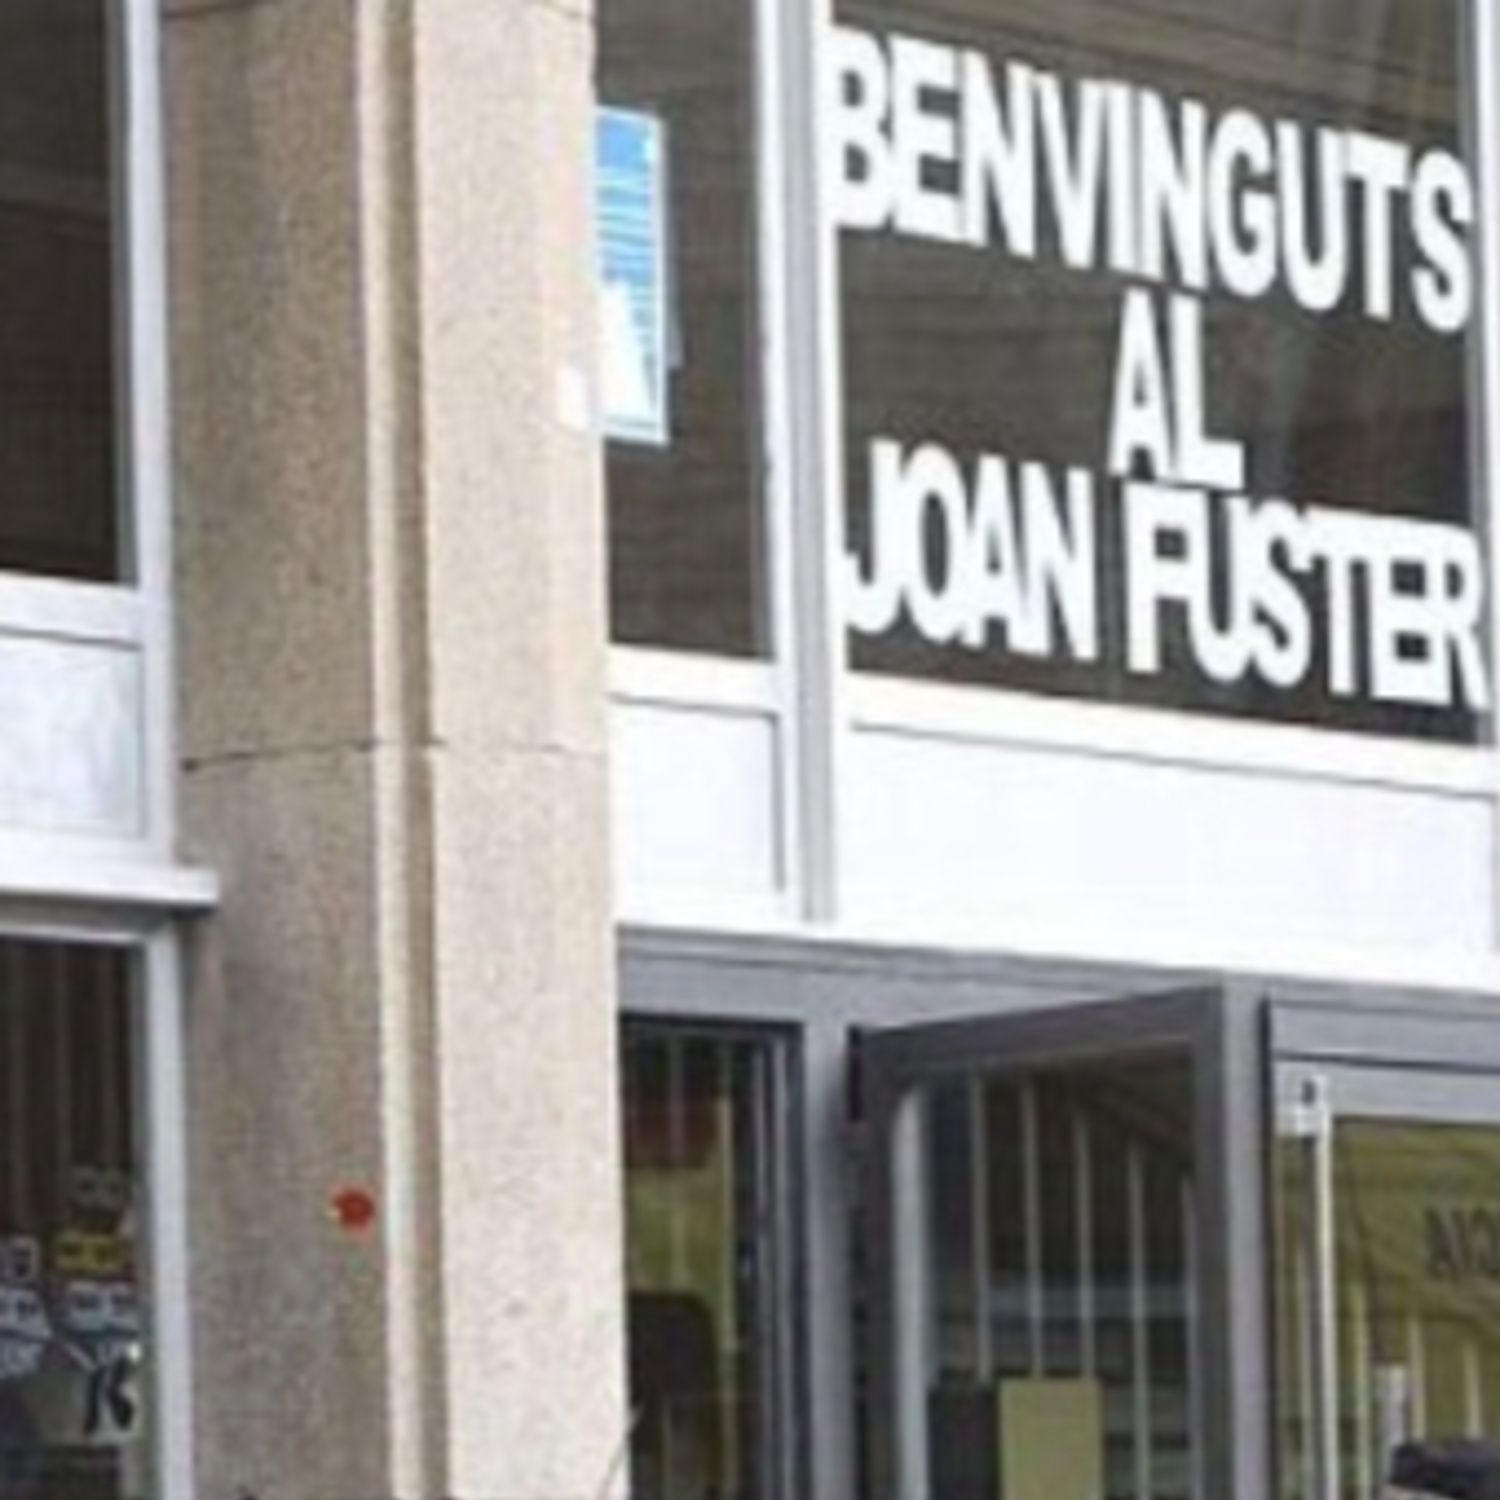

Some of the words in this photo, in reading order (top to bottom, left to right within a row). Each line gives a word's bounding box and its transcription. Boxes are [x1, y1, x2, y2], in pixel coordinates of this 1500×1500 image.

[833, 25, 1473, 332] BENVINGUTS
[1109, 288, 1245, 491] AL
[847, 439, 1096, 662] JOAN
[1123, 481, 1491, 712] FUSTER
